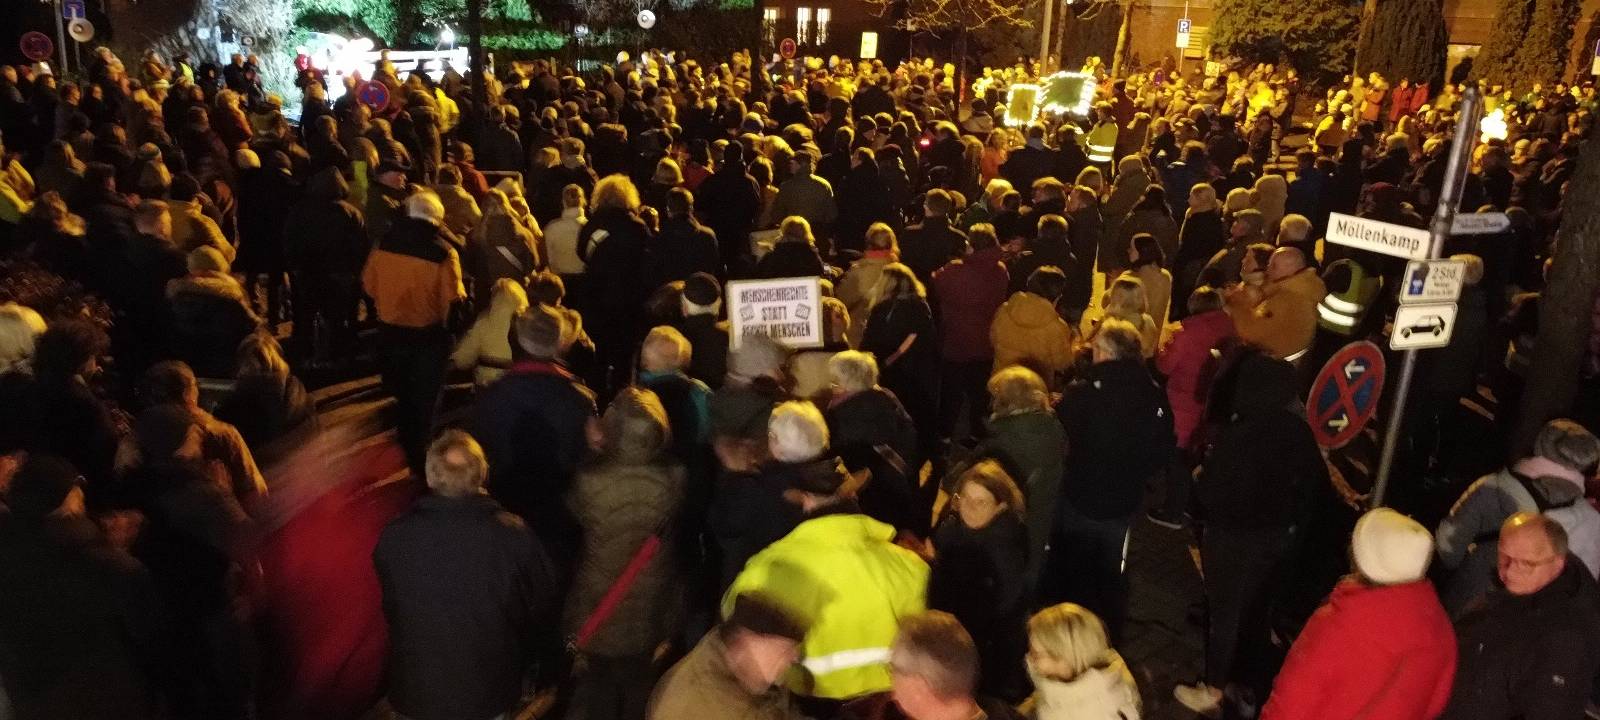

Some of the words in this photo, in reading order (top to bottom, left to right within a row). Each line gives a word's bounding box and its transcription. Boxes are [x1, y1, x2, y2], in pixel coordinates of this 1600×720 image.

[1336, 220, 1420, 253] Möllenkamp
[1432, 267, 1439, 279] 2
[741, 286, 809, 303] MENSCHENRECHTE
[761, 306, 787, 321] STATT
[770, 321, 811, 338] MENSCHEN
